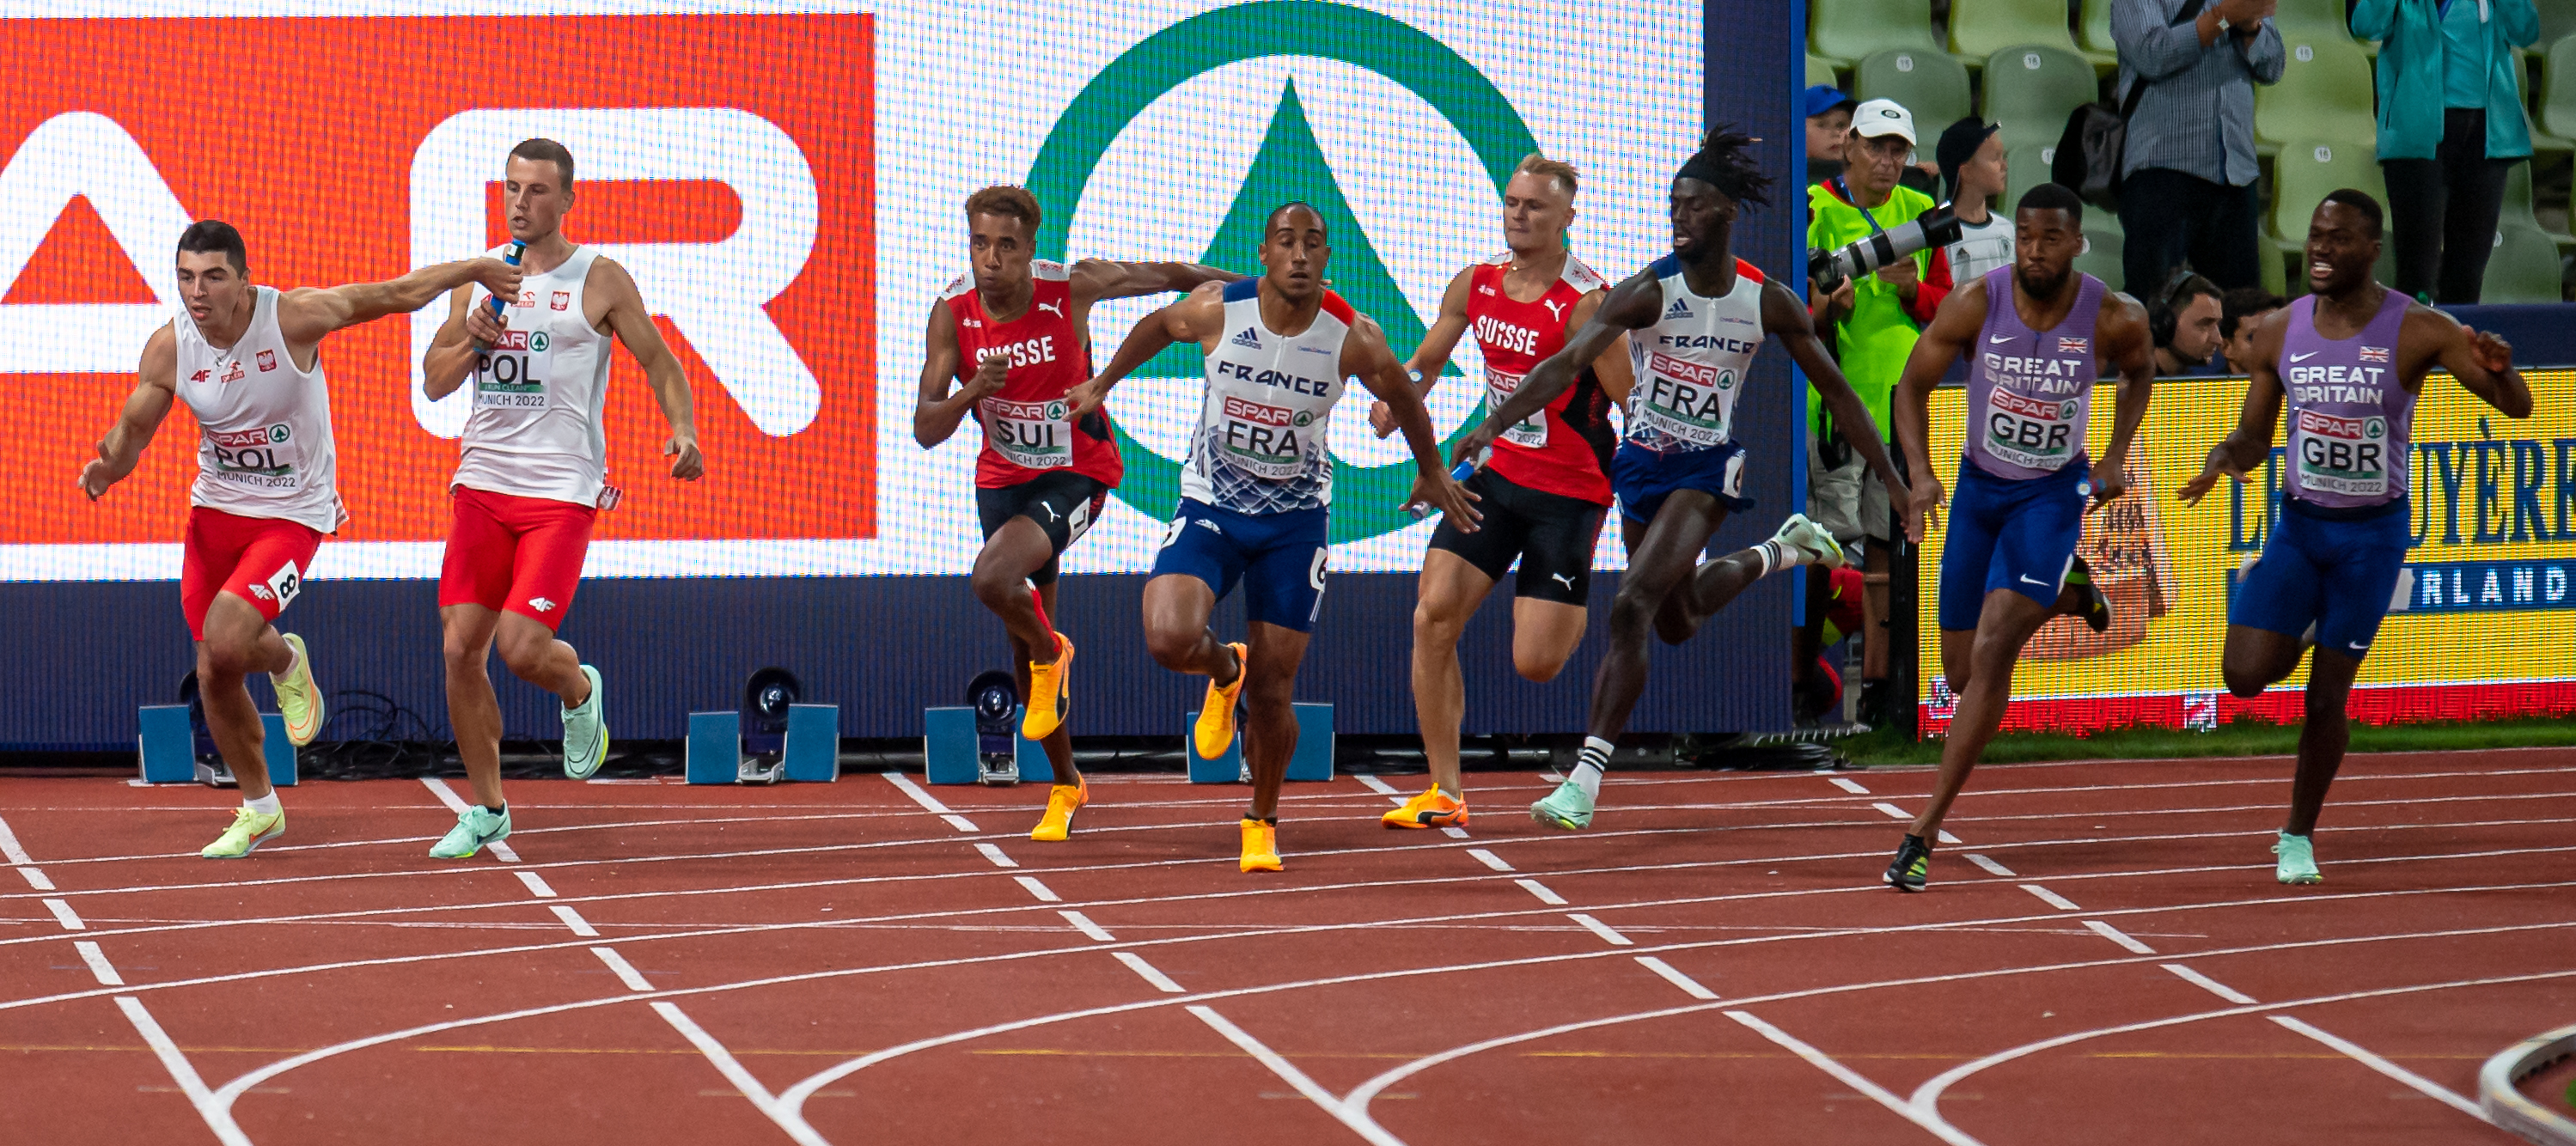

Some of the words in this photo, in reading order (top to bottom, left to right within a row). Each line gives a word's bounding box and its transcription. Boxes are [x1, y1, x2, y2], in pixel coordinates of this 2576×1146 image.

[497, 334, 528, 349] AR
[1659, 335, 1755, 354] FRANCE
[479, 355, 541, 385] POL
[1652, 355, 1715, 385] SPAR
[1984, 353, 2082, 377] GREAT
[2289, 366, 2385, 385] GREAT
[1218, 360, 1329, 397] FRANCE
[478, 393, 511, 406] MUNICH
[516, 395, 545, 406] 2022
[1651, 376, 1722, 423] FRA
[1993, 392, 2058, 418] SPAR
[2292, 386, 2384, 405] BRITAIN
[983, 399, 1043, 419] SPAR
[1226, 399, 1290, 424] SPAR
[996, 419, 1054, 448] SUI
[1643, 407, 1687, 436] MUNICH
[1690, 428, 1720, 444] 2022
[1990, 412, 2071, 449] GBR
[2301, 413, 2361, 437] SPAR
[1227, 420, 1299, 456] FRA
[1517, 432, 1543, 446] 2022
[215, 444, 290, 470] POL
[1036, 456, 1066, 466] 2022
[2303, 436, 2383, 472] GBR
[217, 471, 263, 486] MUNICH
[266, 478, 296, 487] 2022
[1272, 464, 1300, 476] 2022
[2350, 482, 2382, 493] 2022
[279, 573, 296, 599] 8
